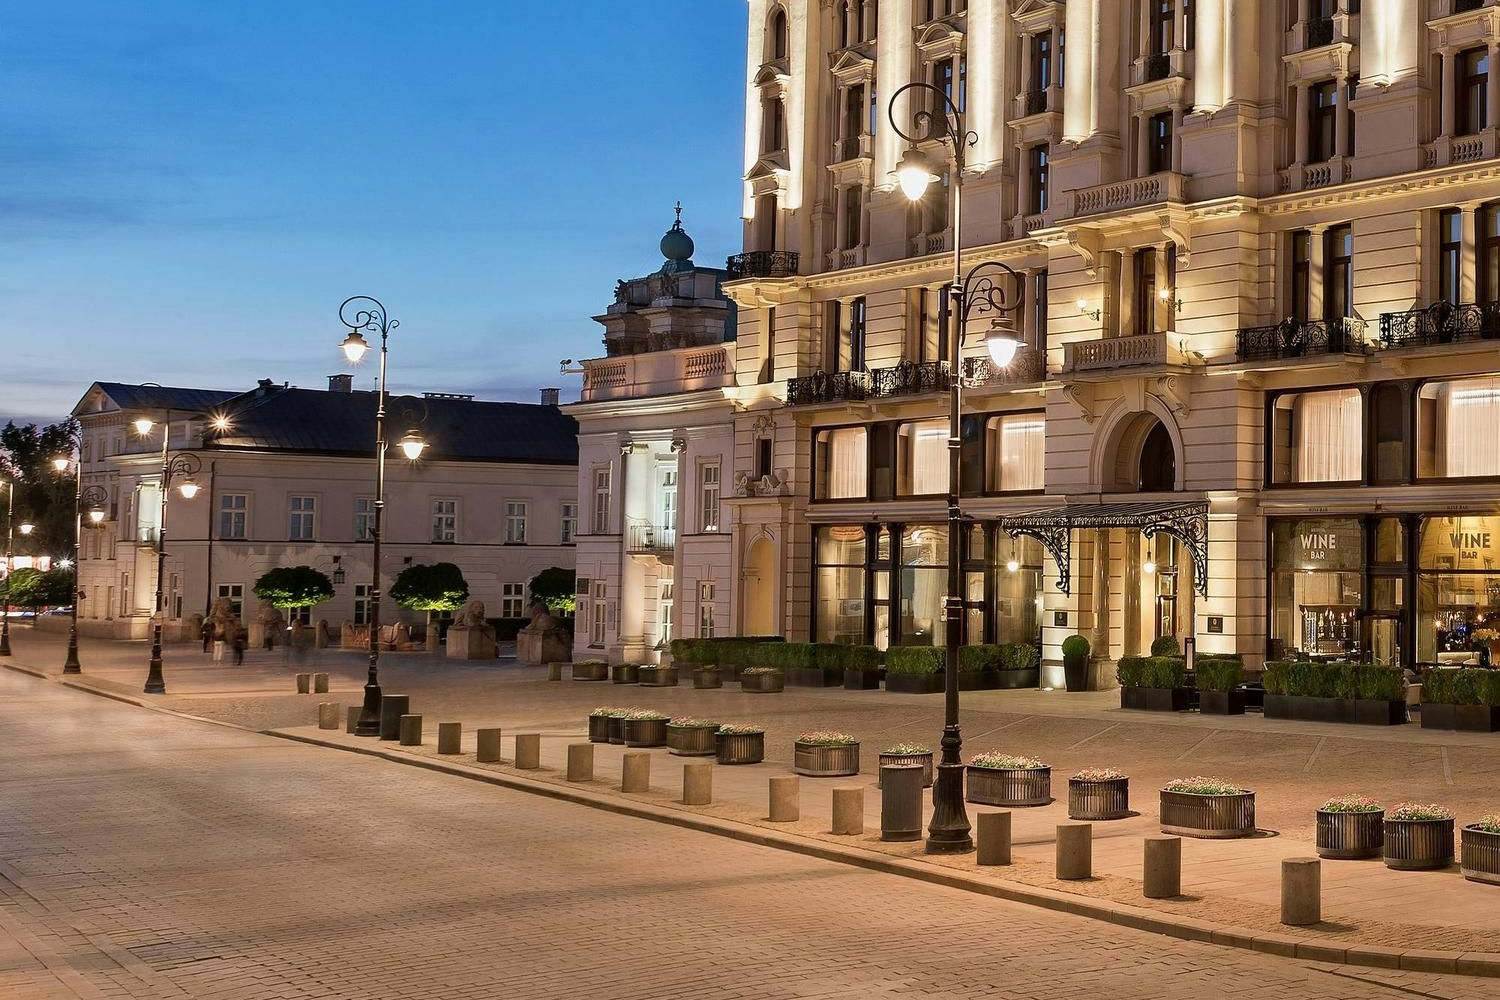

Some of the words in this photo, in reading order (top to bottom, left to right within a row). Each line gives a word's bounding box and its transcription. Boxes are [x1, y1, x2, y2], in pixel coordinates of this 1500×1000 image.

[1300, 534, 1336, 549] WINE
[1449, 533, 1491, 549] WINE
[1310, 551, 1325, 560] BAR
[1461, 551, 1478, 559] BAR
